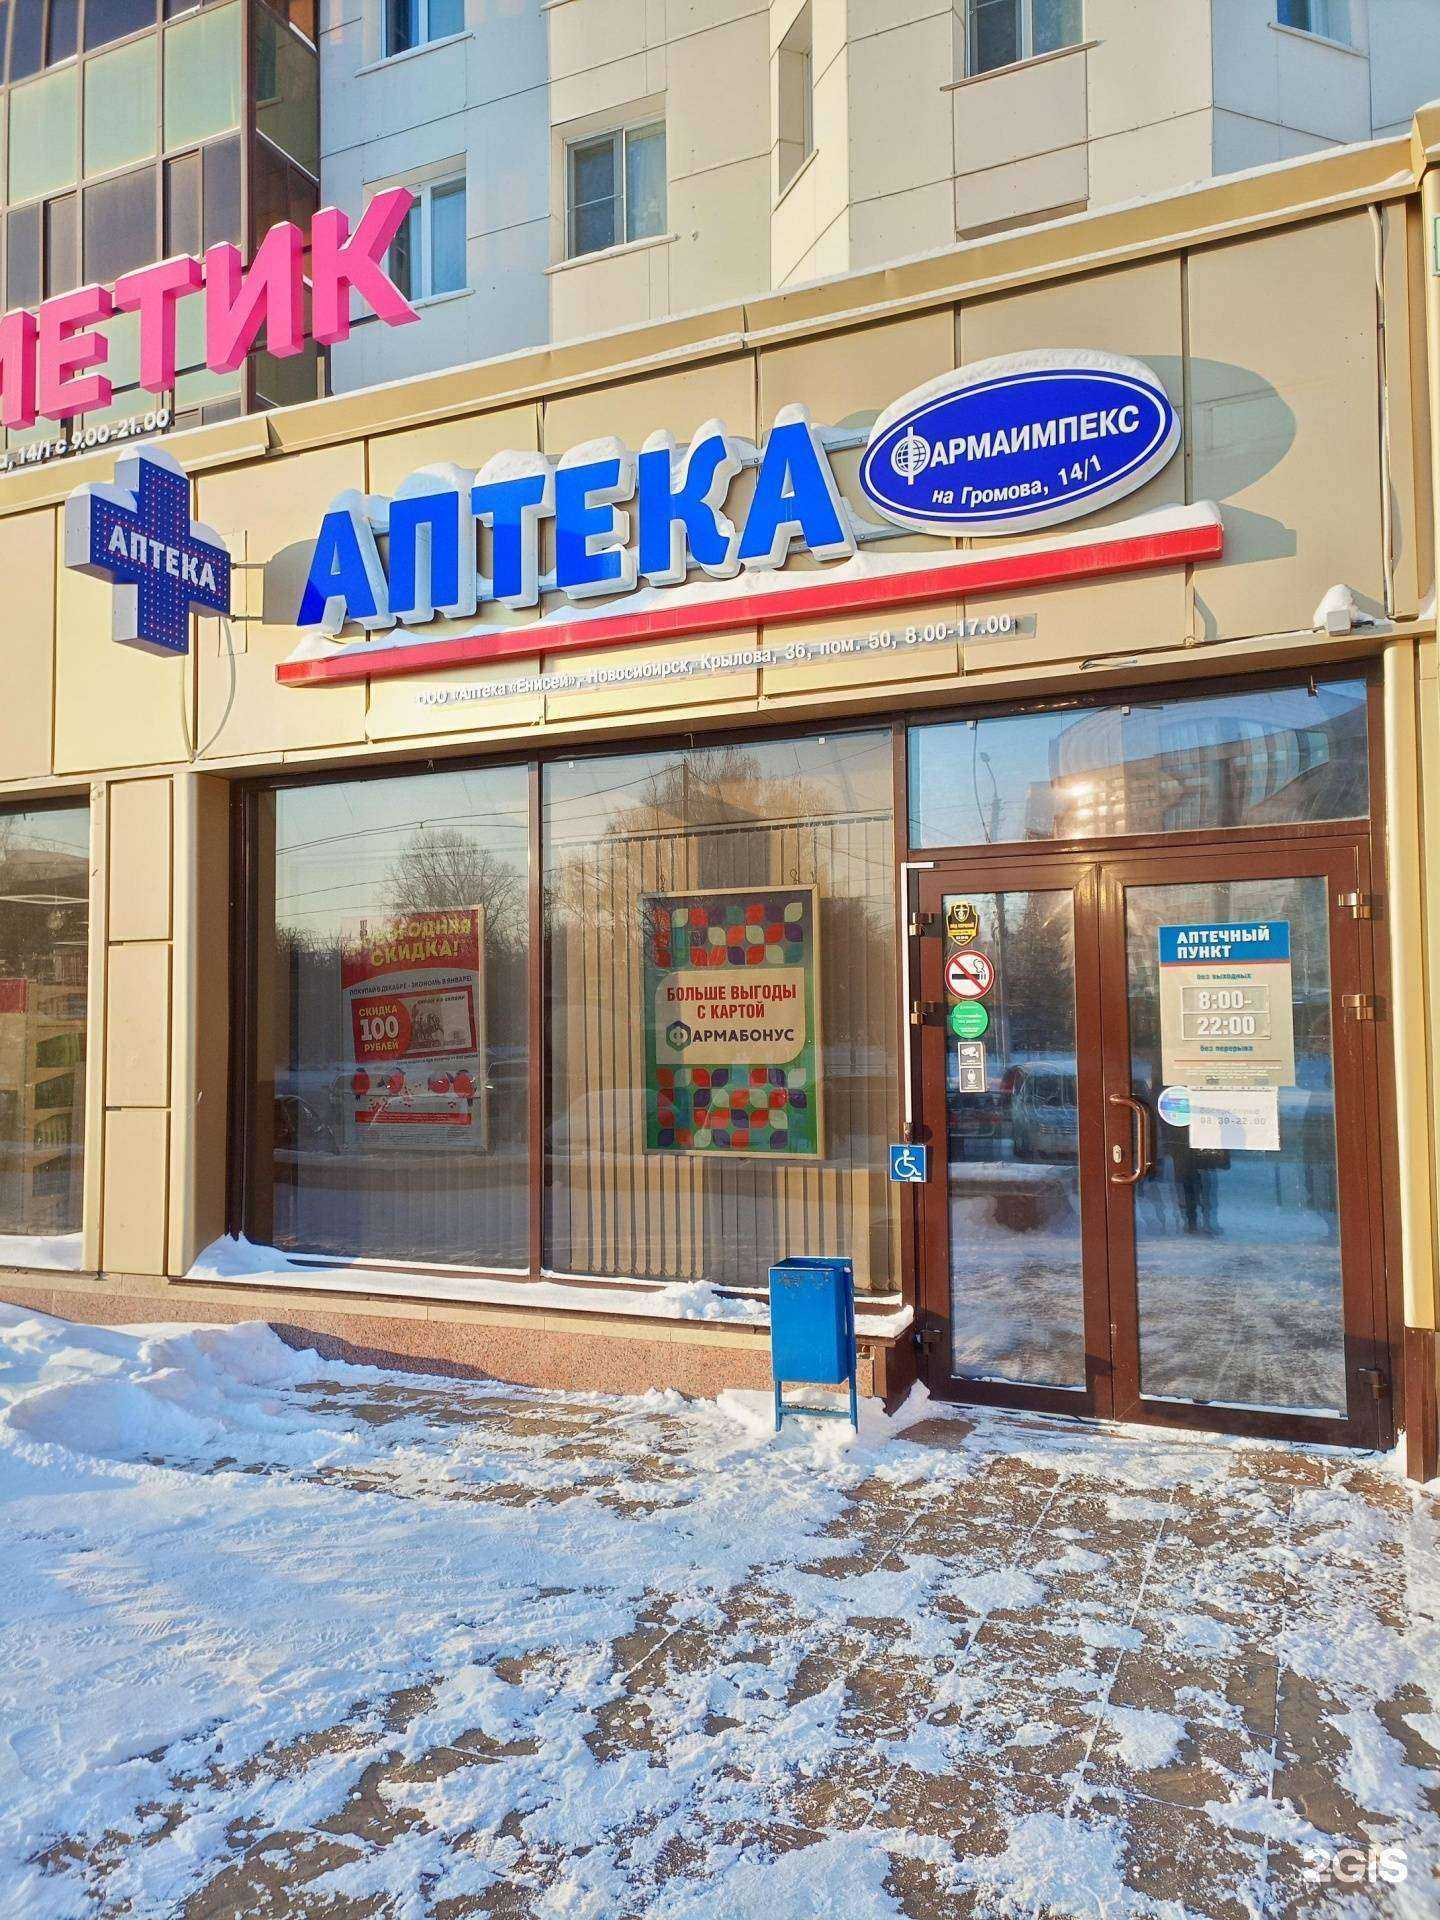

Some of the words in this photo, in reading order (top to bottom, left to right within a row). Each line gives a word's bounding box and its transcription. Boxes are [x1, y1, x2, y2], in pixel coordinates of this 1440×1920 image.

[932, 488, 953, 504] на
[960, 480, 1049, 508] Громова,
[1057, 454, 1101, 486] 14/1
[297, 421, 855, 632] АПТЕКА
[108, 525, 216, 592] АПТЕКА
[700, 648, 777, 671] Крылова,
[786, 642, 812, 662] 36,
[820, 640, 861, 655] пом.
[869, 631, 897, 650] 50,
[905, 614, 1012, 644] 8.00-17.00
[1177, 925, 1270, 943] АПТЕЧНЫЙ
[371, 939, 459, 967] СКИДКА!
[1177, 945, 1232, 959] ПУНКТ
[667, 986, 726, 1001] БОЛЬШЕ
[730, 984, 796, 1001] ВЫГОДЫ
[359, 1004, 399, 1017] СКИДКА
[697, 1004, 706, 1019] С
[710, 1001, 765, 1019] КАРТОЙ
[360, 1015, 399, 1041] 100
[1197, 1015, 1256, 1035] 22:00
[364, 1039, 399, 1052] РУБЛЕЙ
